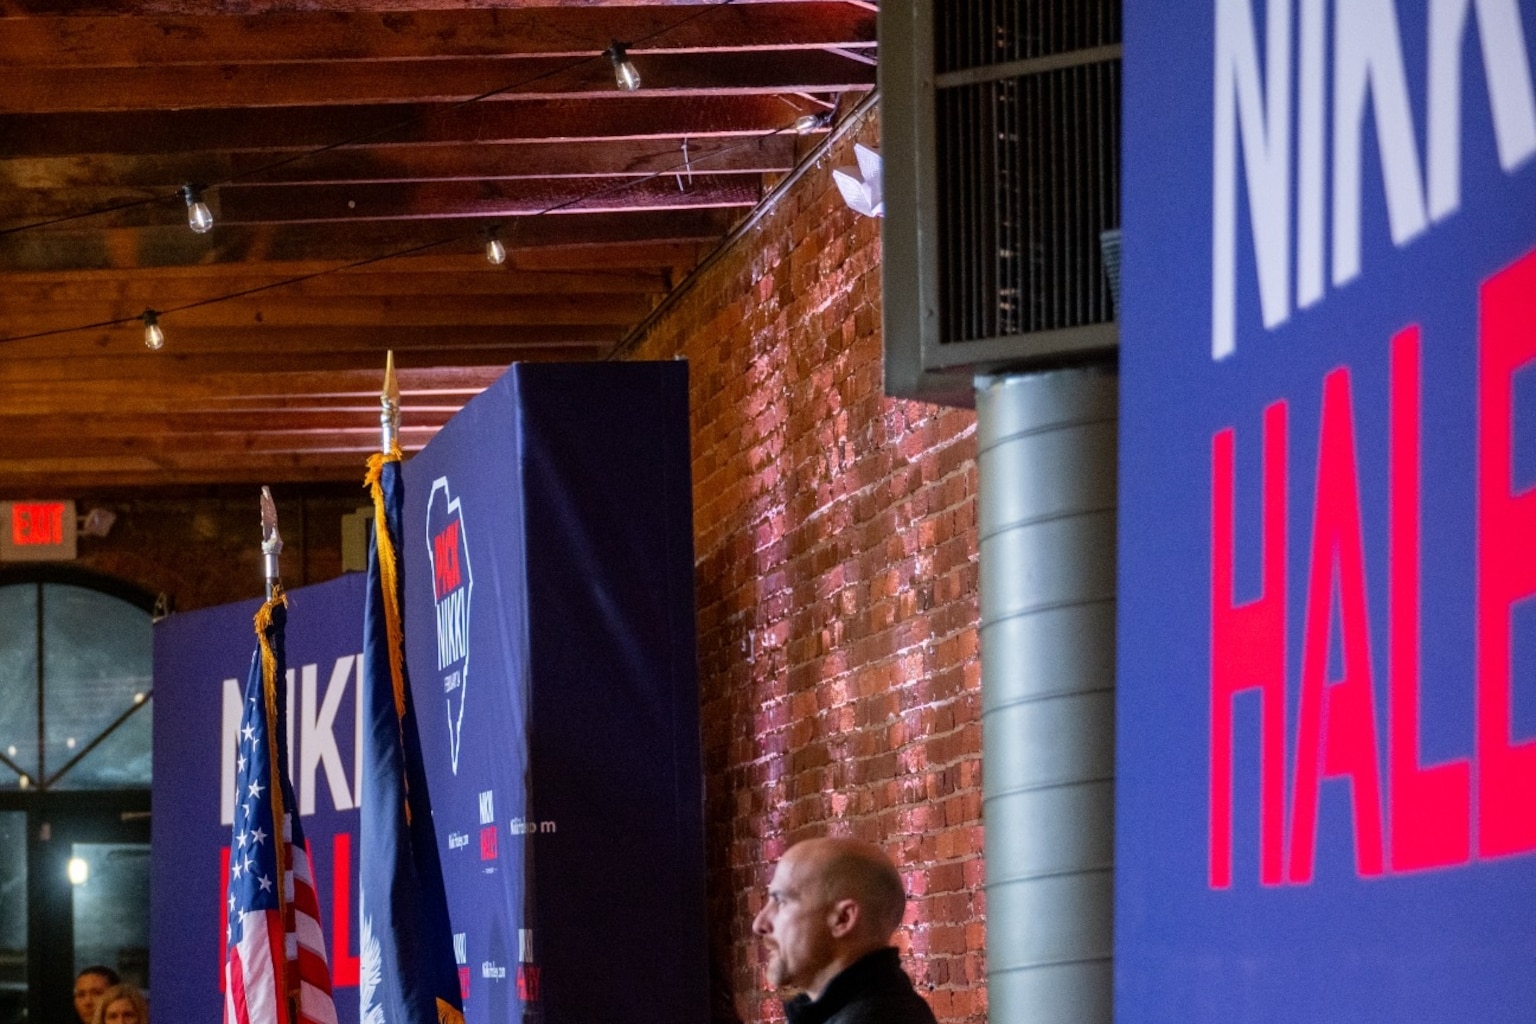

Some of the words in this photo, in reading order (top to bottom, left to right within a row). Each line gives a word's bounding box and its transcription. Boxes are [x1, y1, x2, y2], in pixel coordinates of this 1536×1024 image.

[12, 503, 65, 545] EXIT
[434, 519, 461, 600] PICK
[436, 587, 467, 672] NIKKI
